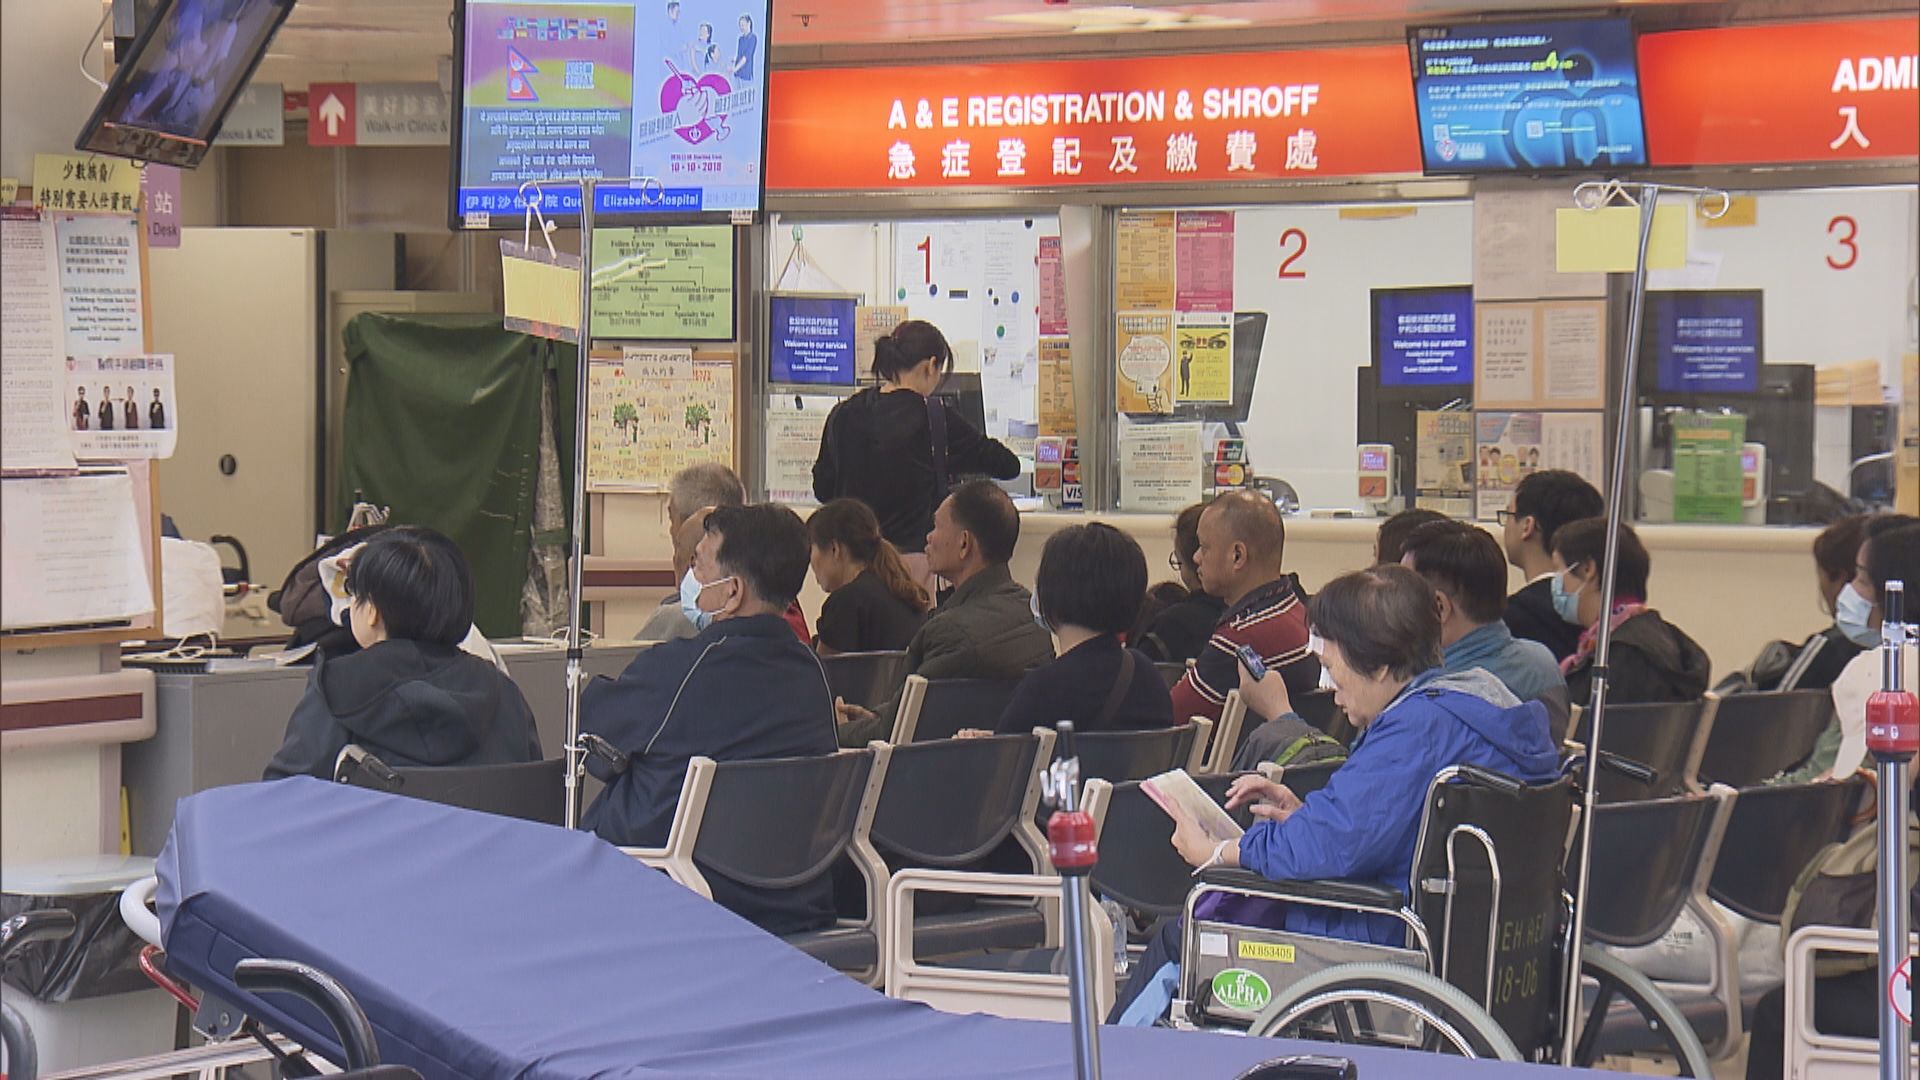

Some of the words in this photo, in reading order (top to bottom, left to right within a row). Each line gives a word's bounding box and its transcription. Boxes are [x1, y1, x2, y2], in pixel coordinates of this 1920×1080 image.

[888, 98, 907, 129] A
[916, 99, 933, 129] &
[942, 97, 958, 128] E
[967, 91, 1164, 127] REGISTRATION
[1175, 90, 1193, 120] &
[1202, 84, 1320, 119] SHROFF
[364, 119, 406, 134] Walk-in
[407, 119, 438, 134] Clinic
[887, 129, 1319, 180] 急症登記及繳費處
[153, 222, 178, 237] Desk
[641, 240, 655, 248] Area
[664, 240, 699, 248] Observation
[1826, 215, 1858, 270] 3
[917, 235, 931, 285] 1
[1278, 226, 1307, 279] 2
[671, 285, 701, 293] Additional
[594, 310, 624, 319] Emergency
[783, 339, 809, 349] Welcome
[809, 340, 815, 349] to
[825, 341, 848, 350] services
[1393, 340, 1422, 350] Welcome
[1422, 340, 1429, 348] to
[1441, 339, 1467, 348] services
[1065, 487, 1082, 499] VIS
[1216, 983, 1264, 1006] ALPHA
